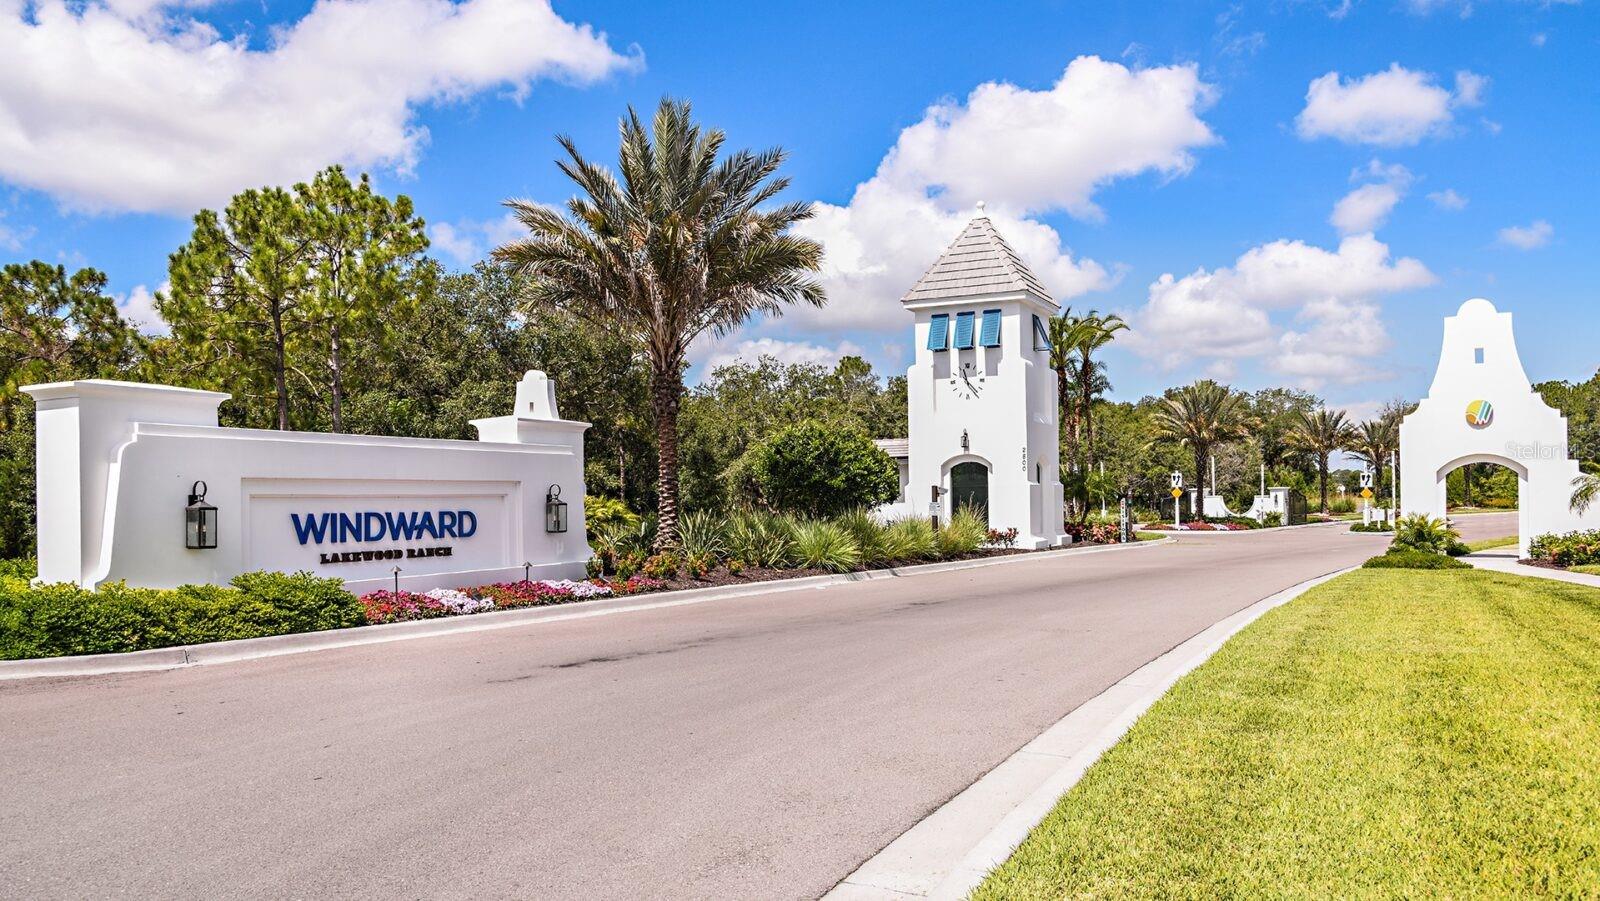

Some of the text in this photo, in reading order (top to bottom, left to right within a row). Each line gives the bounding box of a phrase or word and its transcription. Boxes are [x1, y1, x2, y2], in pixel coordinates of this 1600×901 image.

[291, 510, 478, 545] WINDWARD
[320, 547, 453, 564] LAKEWOOD RANCH
